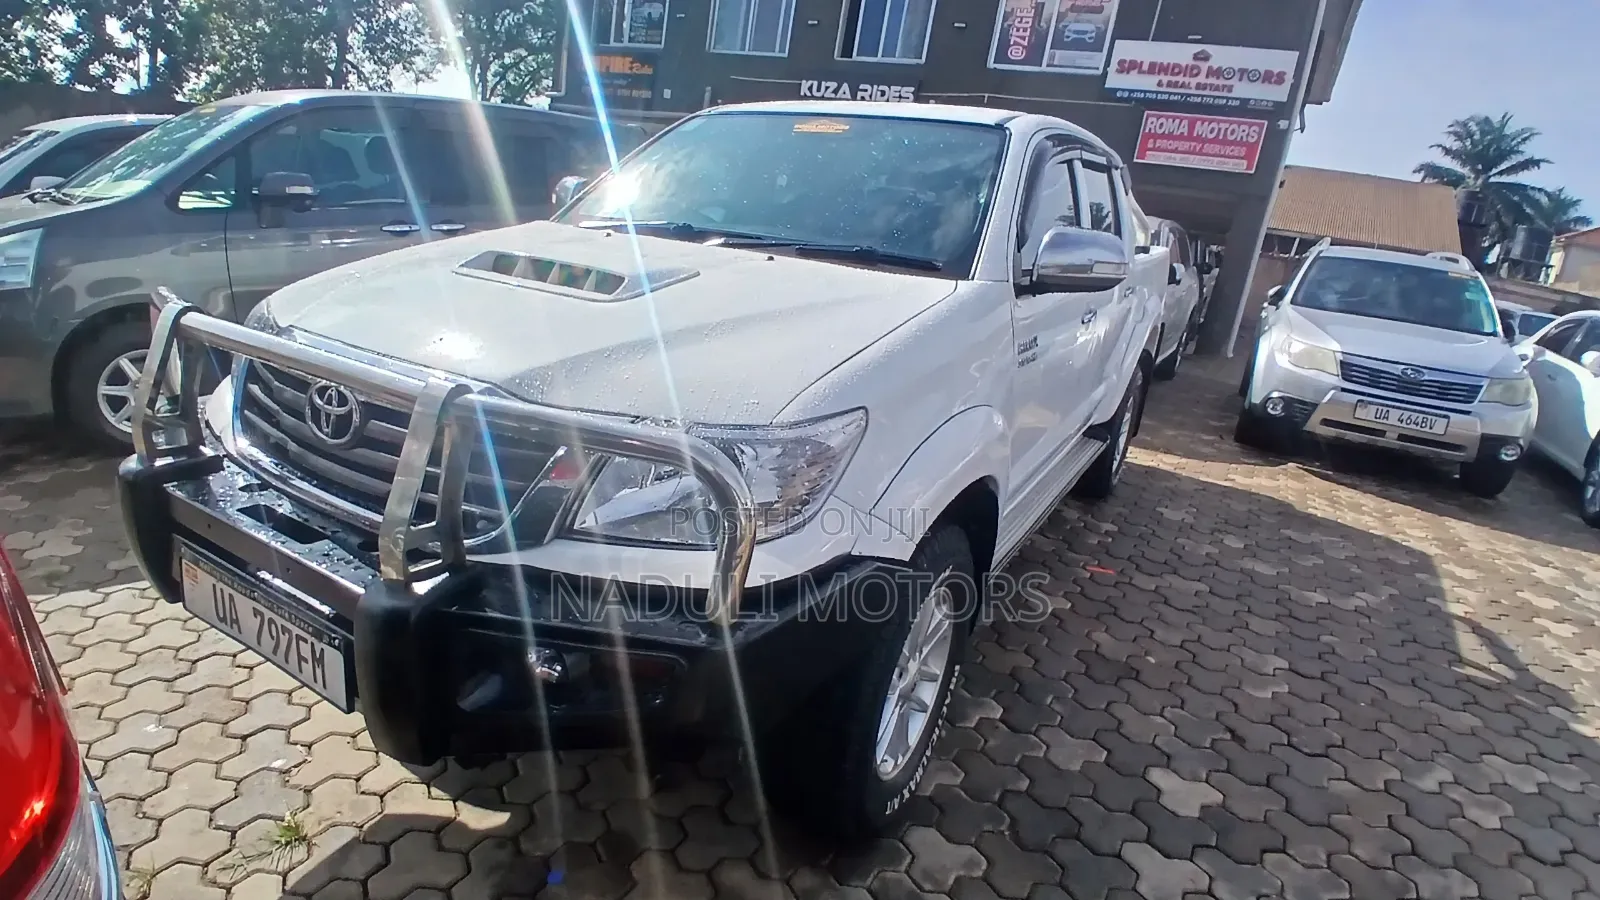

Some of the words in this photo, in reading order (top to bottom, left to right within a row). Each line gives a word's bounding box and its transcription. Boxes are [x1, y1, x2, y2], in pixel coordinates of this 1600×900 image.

[1115, 58, 1201, 79] SPLENDID
[1205, 64, 1287, 86] MOTORS
[800, 79, 852, 99] KUZA
[856, 83, 916, 103] RIDES
[1167, 80, 1193, 91] REAL
[1195, 82, 1235, 94] ESTATE
[1145, 117, 1189, 136] ROMA
[1193, 121, 1260, 143] MOTORS
[1155, 139, 1202, 153] PROPERTY
[1203, 143, 1247, 157] SERVICES
[1374, 407, 1390, 421] UA
[1397, 412, 1438, 430] 464BV
[212, 583, 242, 635] UA
[252, 606, 327, 690] 797FM
